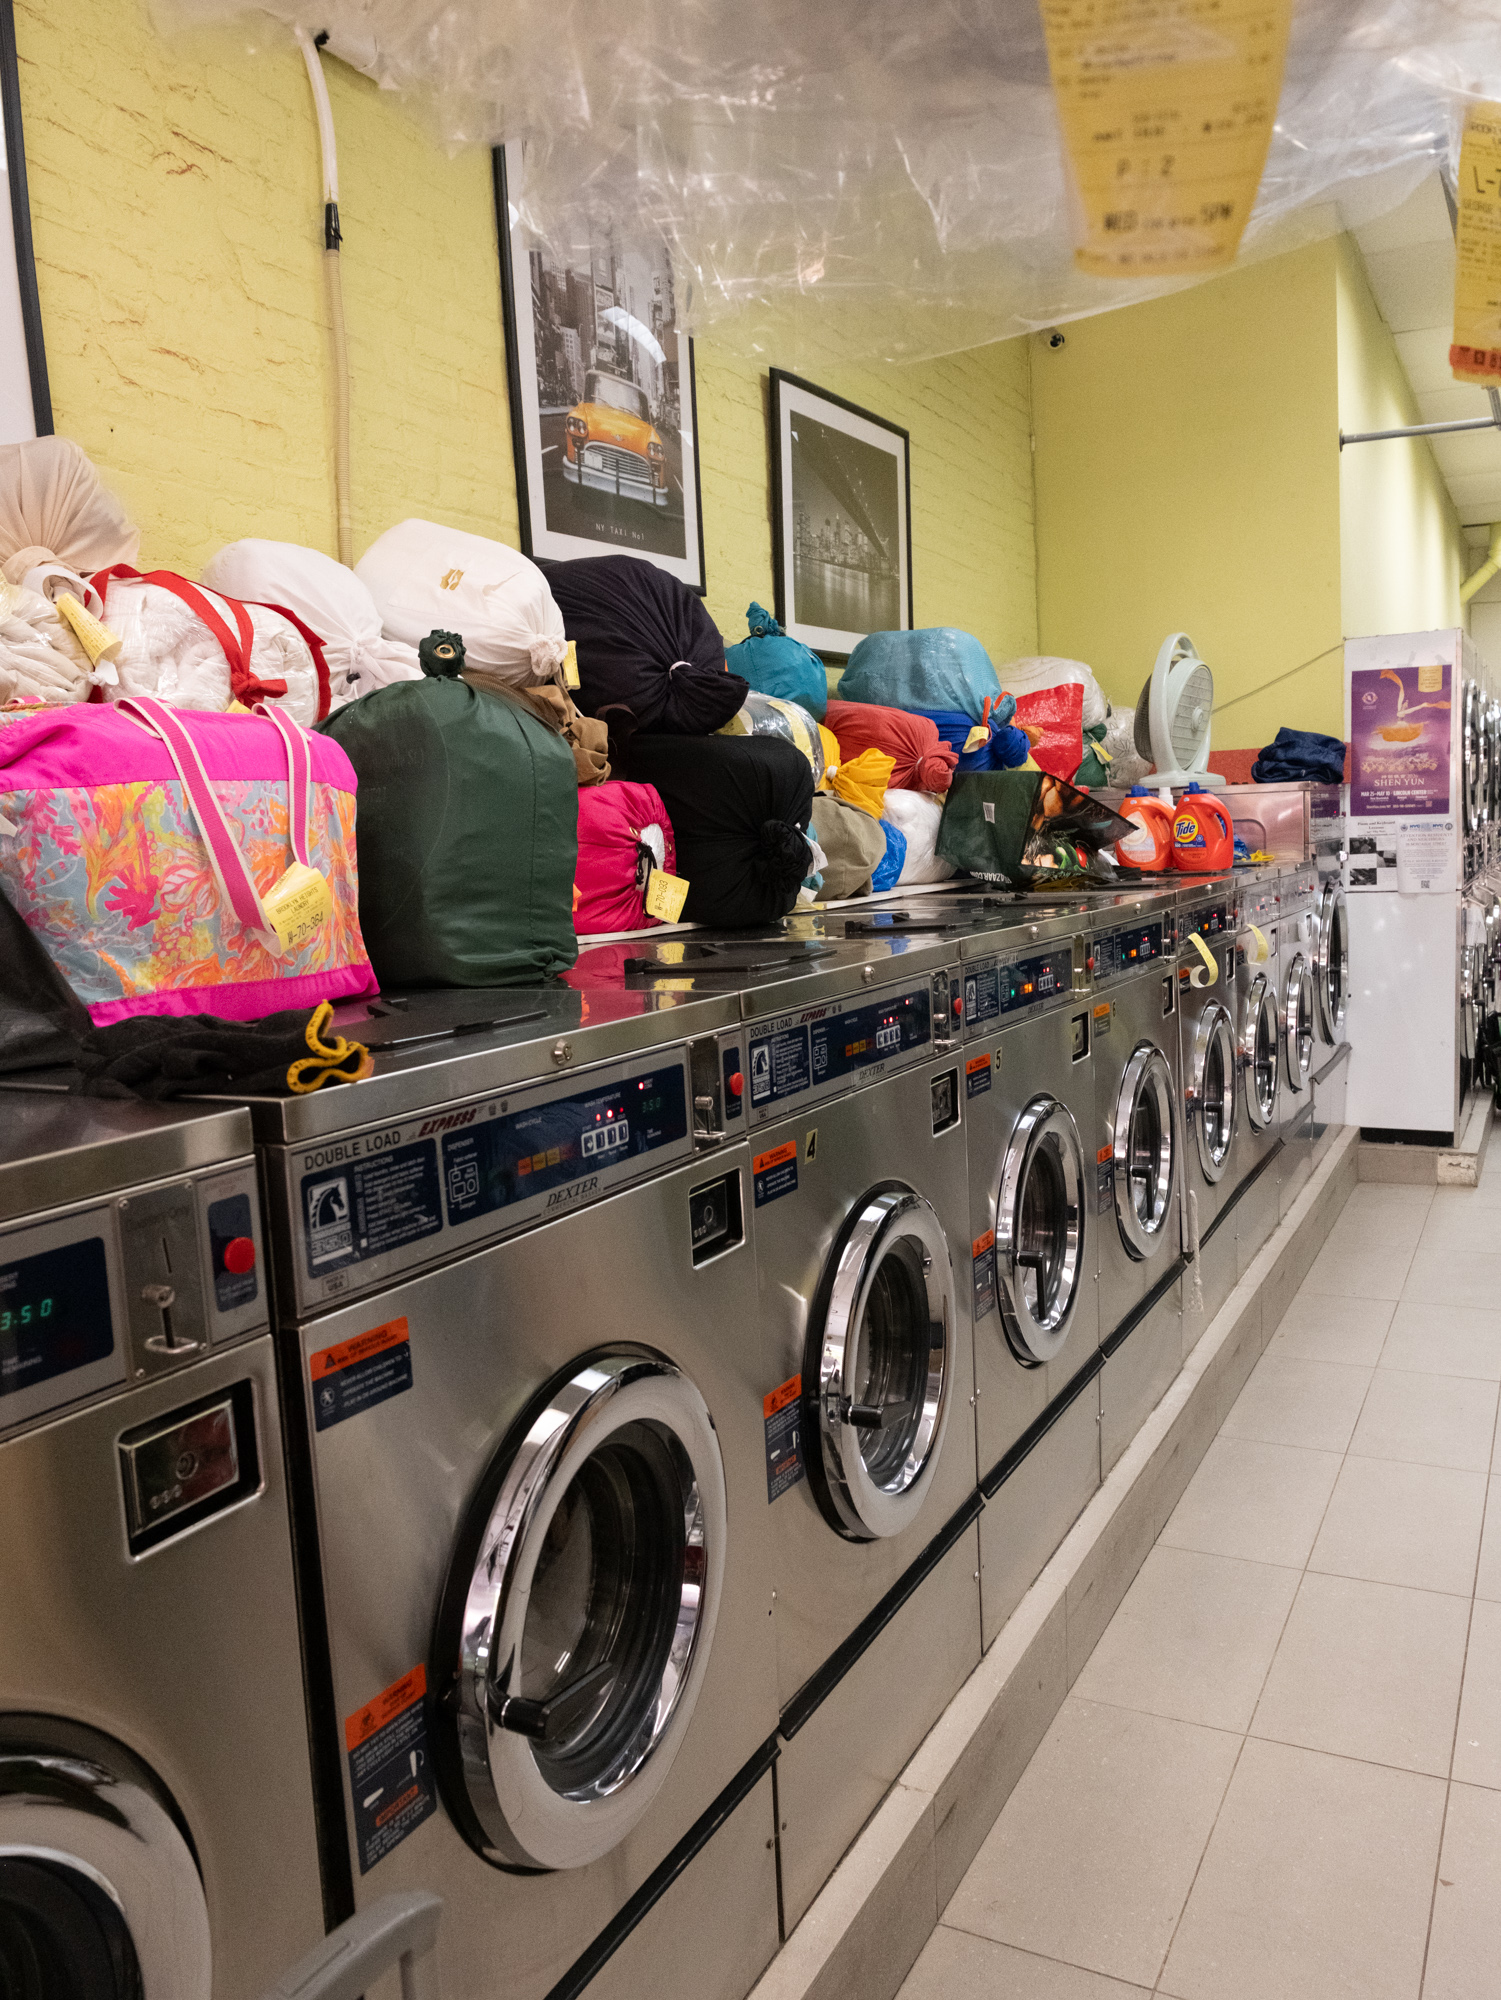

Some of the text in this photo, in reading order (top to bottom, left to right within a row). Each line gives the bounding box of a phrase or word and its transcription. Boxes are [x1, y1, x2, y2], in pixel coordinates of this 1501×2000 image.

[595, 522, 605, 532] NY
[610, 525, 627, 537] TAXI
[1374, 777, 1425, 787] SHEN YUN
[1176, 821, 1196, 838] Tide
[275, 897, 299, 914] BROOKLYN
[298, 886, 319, 902] HEIGHTS
[291, 900, 310, 914] LAUNDRY
[980, 961, 990, 970] LOAD
[750, 1008, 827, 1039] DOUBLE LOAD EXPRESS
[995, 1050, 1001, 1069] 5
[859, 1063, 885, 1081] DEXTER
[304, 1108, 478, 1171] DOUBLE LOAD EXPRESS
[806, 1131, 816, 1159] 4
[546, 1177, 598, 1208] DEXTER
[327, 1281, 344, 1292] USA
[0, 1298, 53, 1331] 3.50
